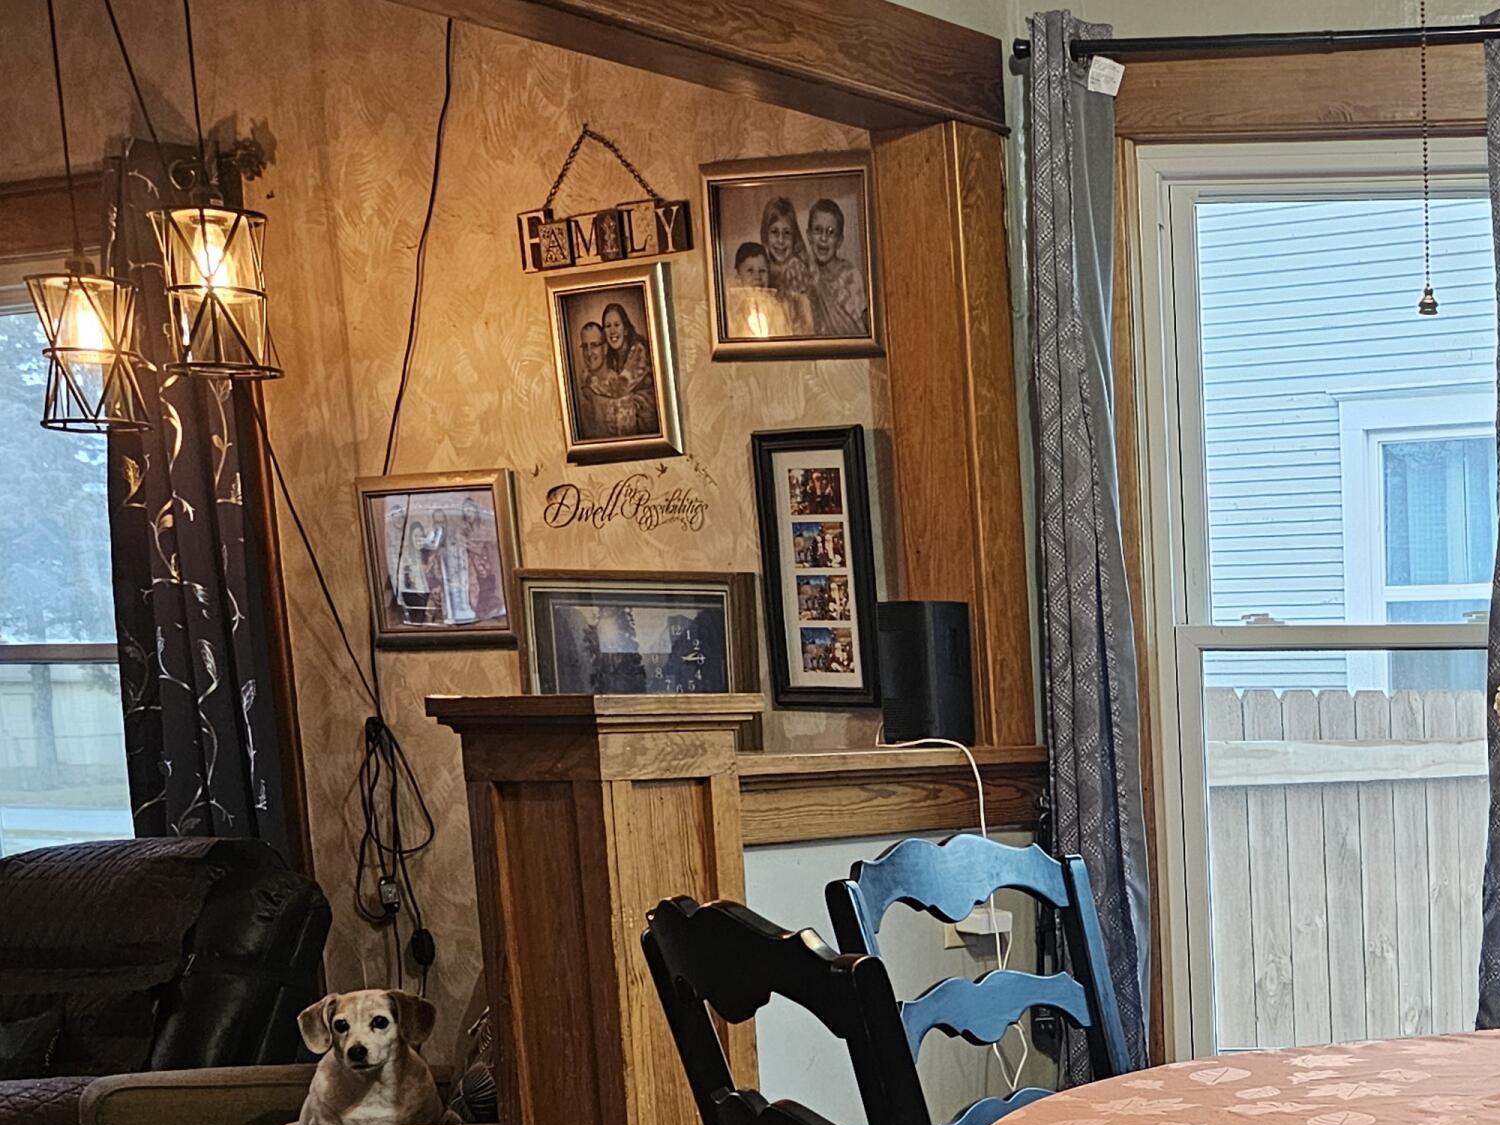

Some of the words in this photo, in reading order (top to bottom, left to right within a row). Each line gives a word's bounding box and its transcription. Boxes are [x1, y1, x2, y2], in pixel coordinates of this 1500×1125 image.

[518, 205, 680, 273] FAMILY
[543, 474, 649, 529] Dwell
[671, 624, 682, 635] 12
[686, 629, 691, 640] 1
[692, 639, 700, 650] 2
[655, 667, 663, 679] 8
[695, 669, 702, 680] 4
[665, 679, 671, 691] 7
[688, 680, 695, 690] 5
